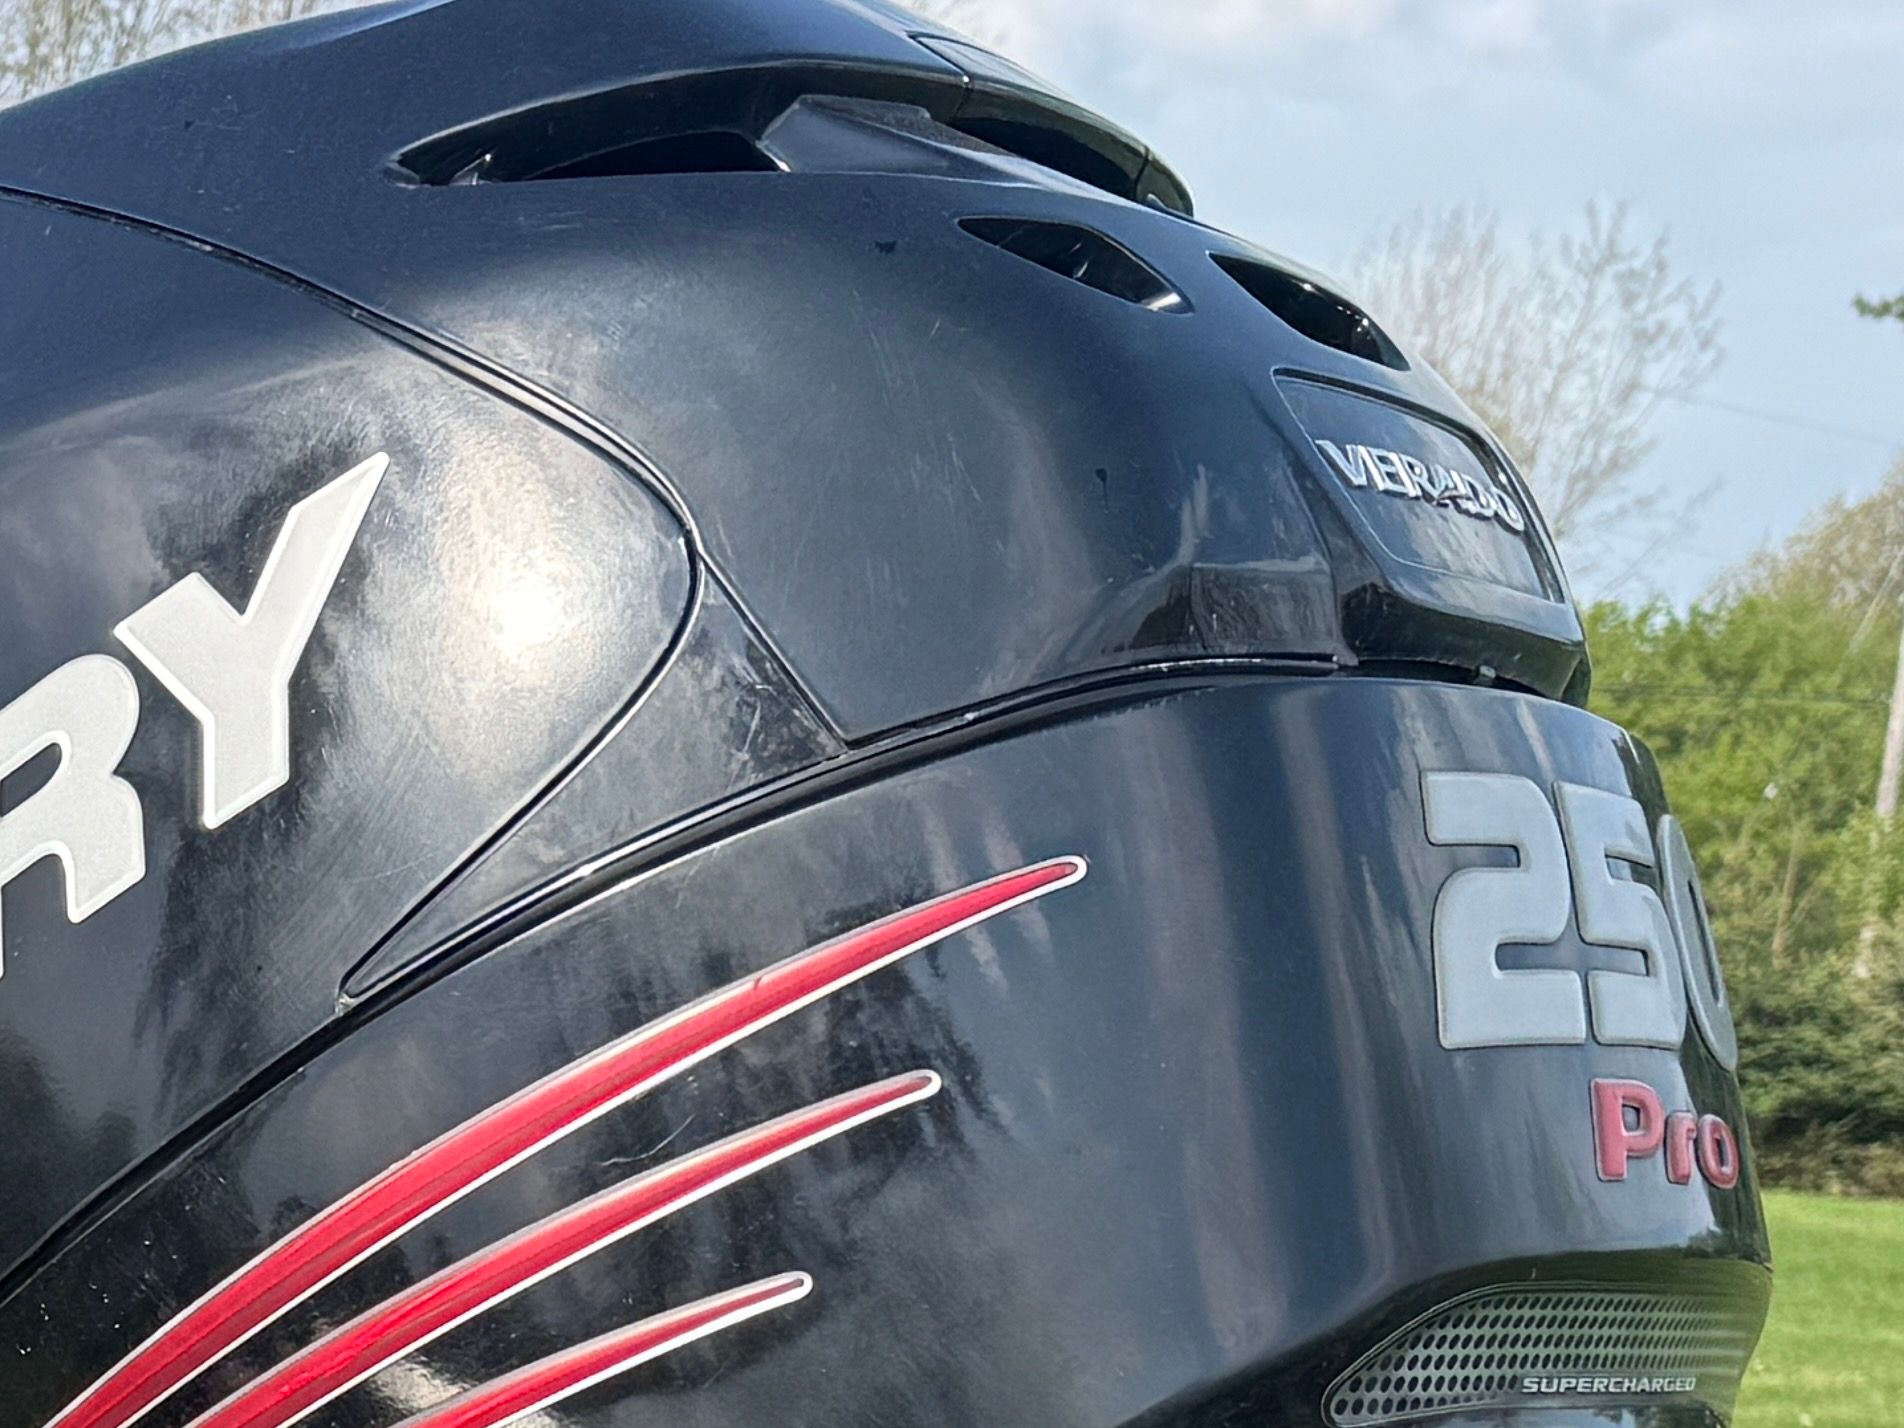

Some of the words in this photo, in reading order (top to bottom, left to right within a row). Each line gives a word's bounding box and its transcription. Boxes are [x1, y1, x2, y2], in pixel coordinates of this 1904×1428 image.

[1315, 440, 1526, 532] VERADO
[1421, 772, 1738, 1072] 250
[1590, 1078, 1739, 1189] Pro
[1521, 1374, 1696, 1395] SUPERCHARGED
